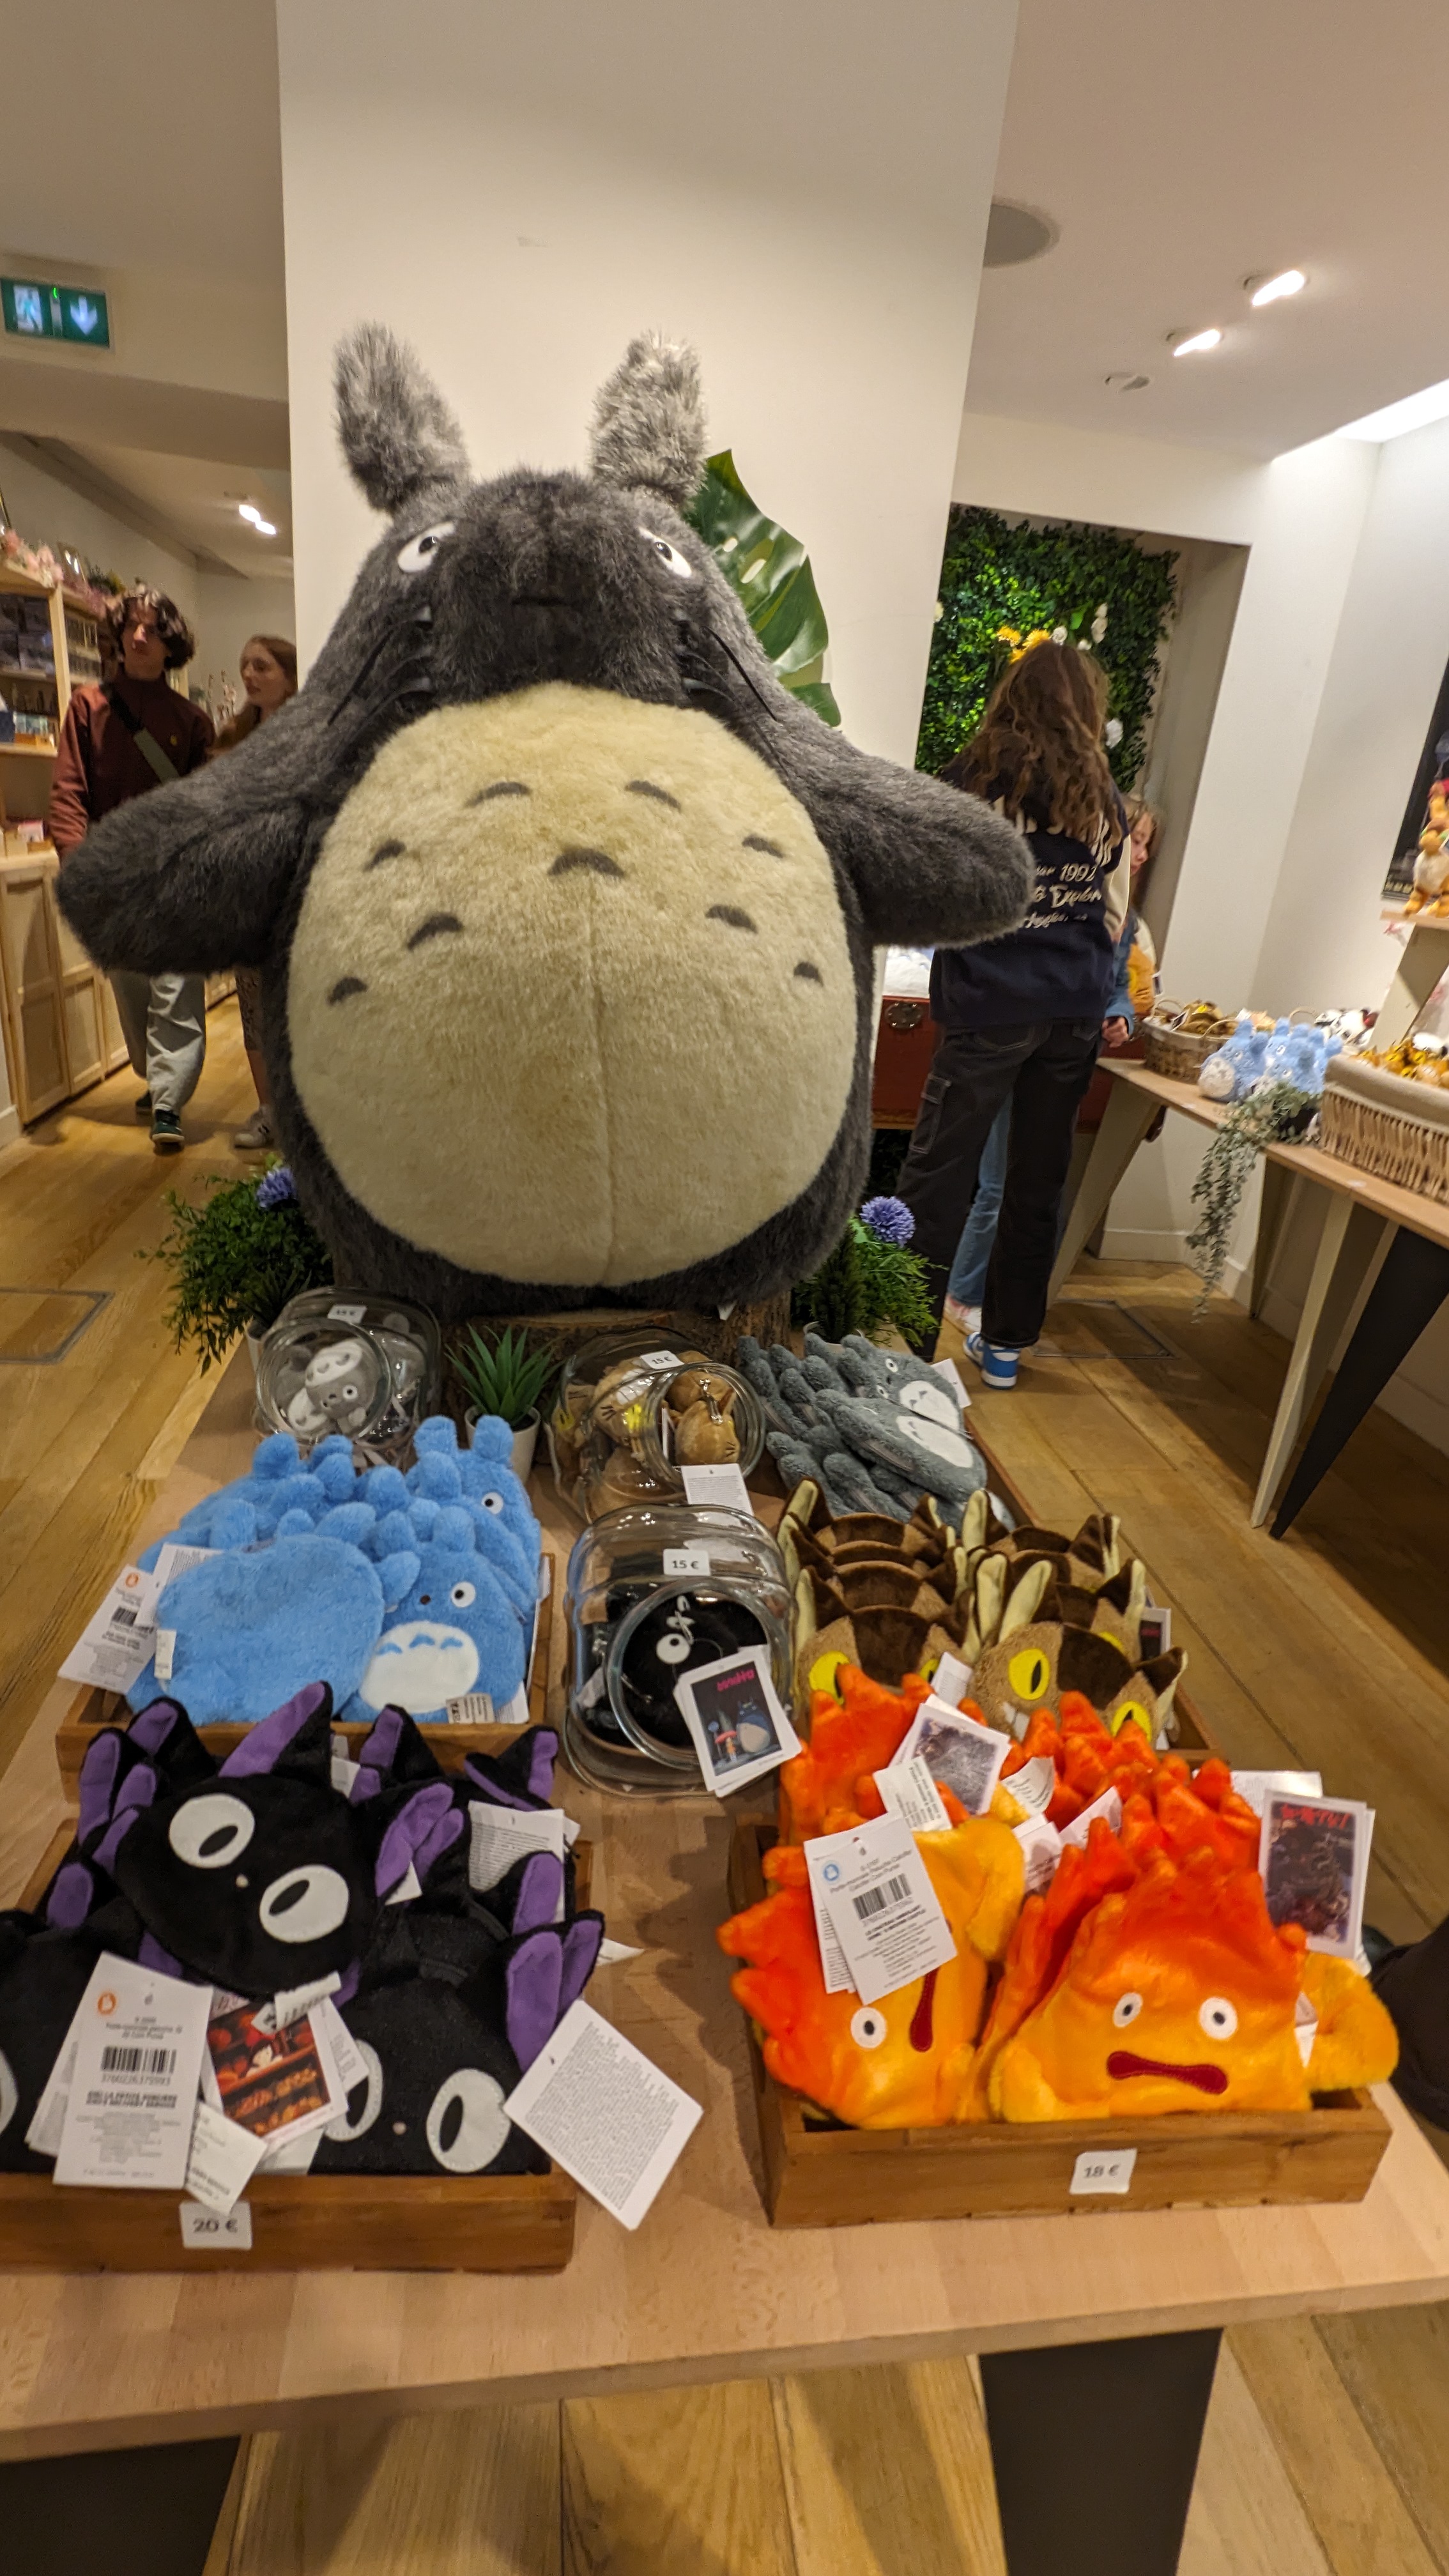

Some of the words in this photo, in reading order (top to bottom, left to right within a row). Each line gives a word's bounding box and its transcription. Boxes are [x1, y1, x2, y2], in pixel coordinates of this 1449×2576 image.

[1060, 863, 1097, 882] 1992
[672, 1560, 687, 1569] 15
[691, 1561, 699, 1569] €
[1084, 2165, 1105, 2178] 18
[1108, 2164, 1121, 2177] €
[194, 2218, 220, 2233] 20
[226, 2218, 238, 2233] €
